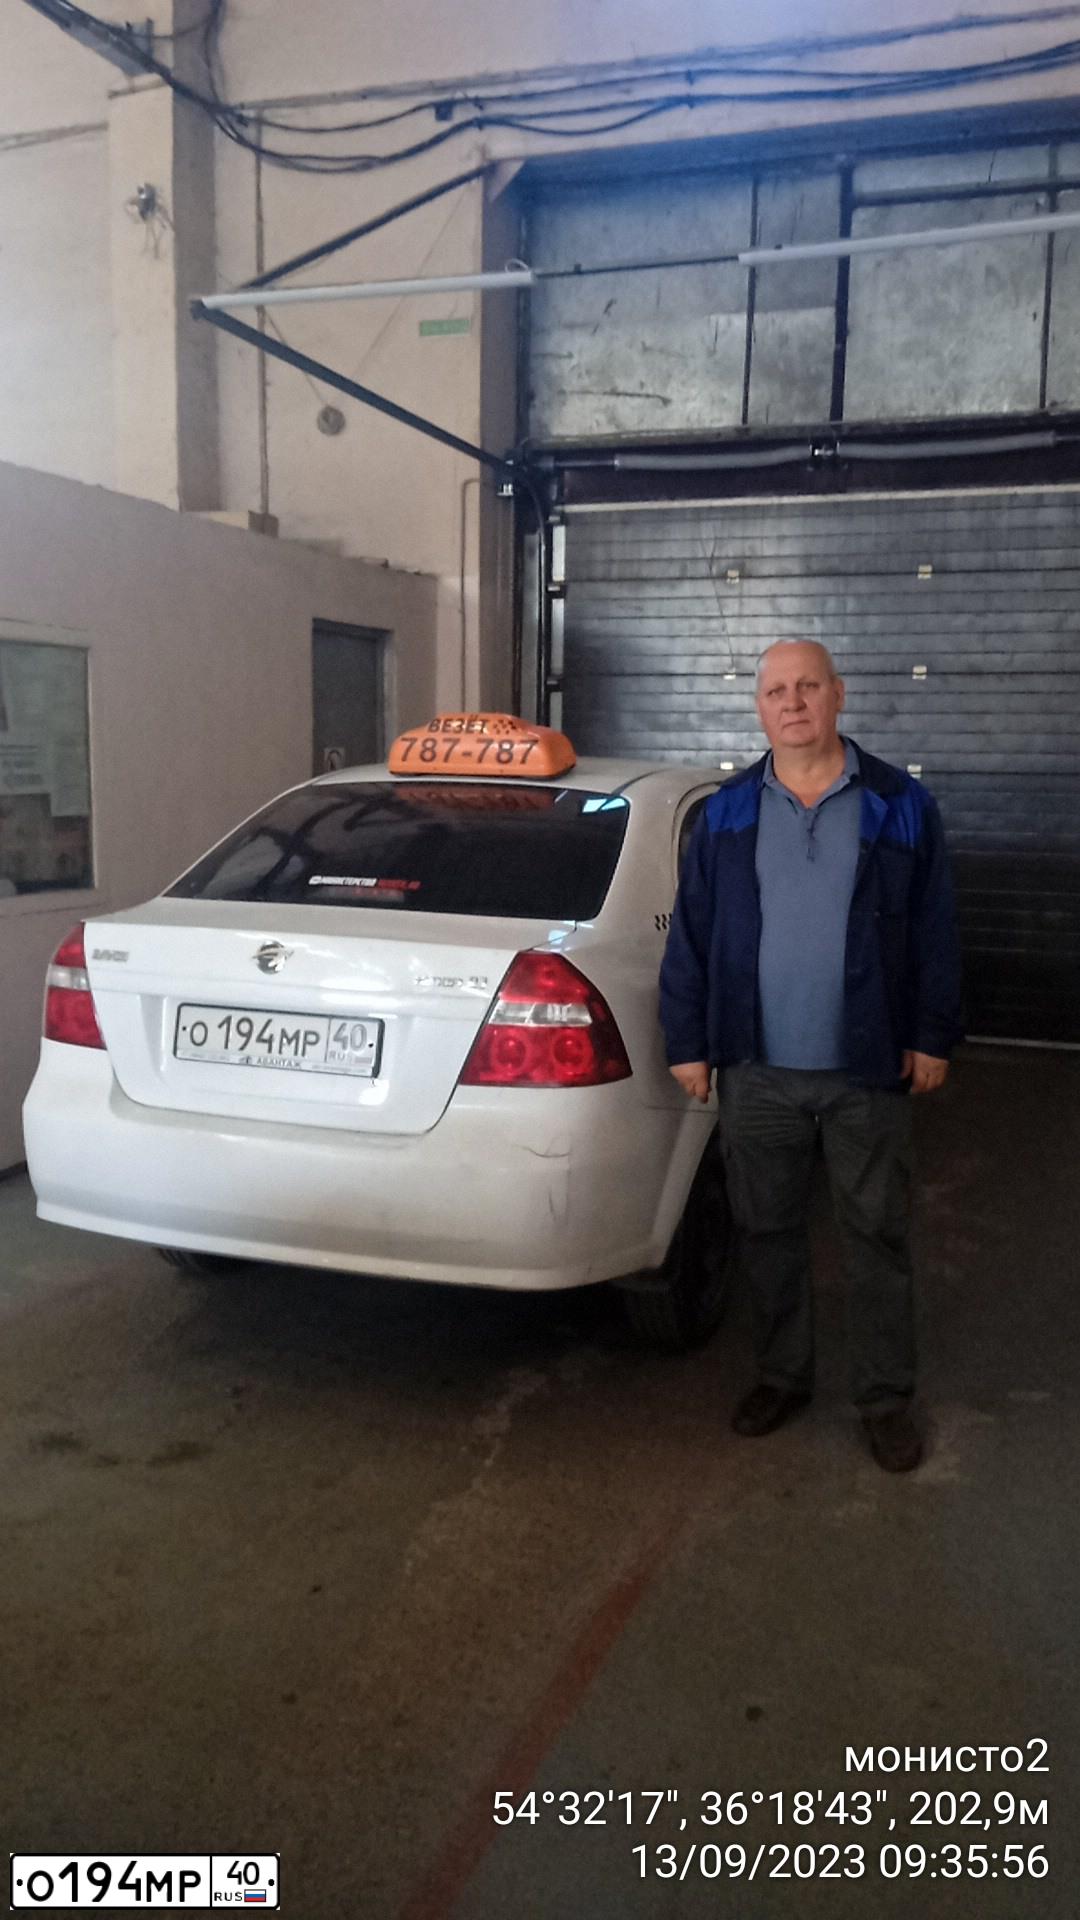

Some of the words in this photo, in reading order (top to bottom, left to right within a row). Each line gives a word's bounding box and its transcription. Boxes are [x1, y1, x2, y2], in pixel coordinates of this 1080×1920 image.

[427, 715, 489, 734] ВЕЗЁТ
[400, 737, 538, 764] 787-787
[332, 1022, 368, 1051] 40
